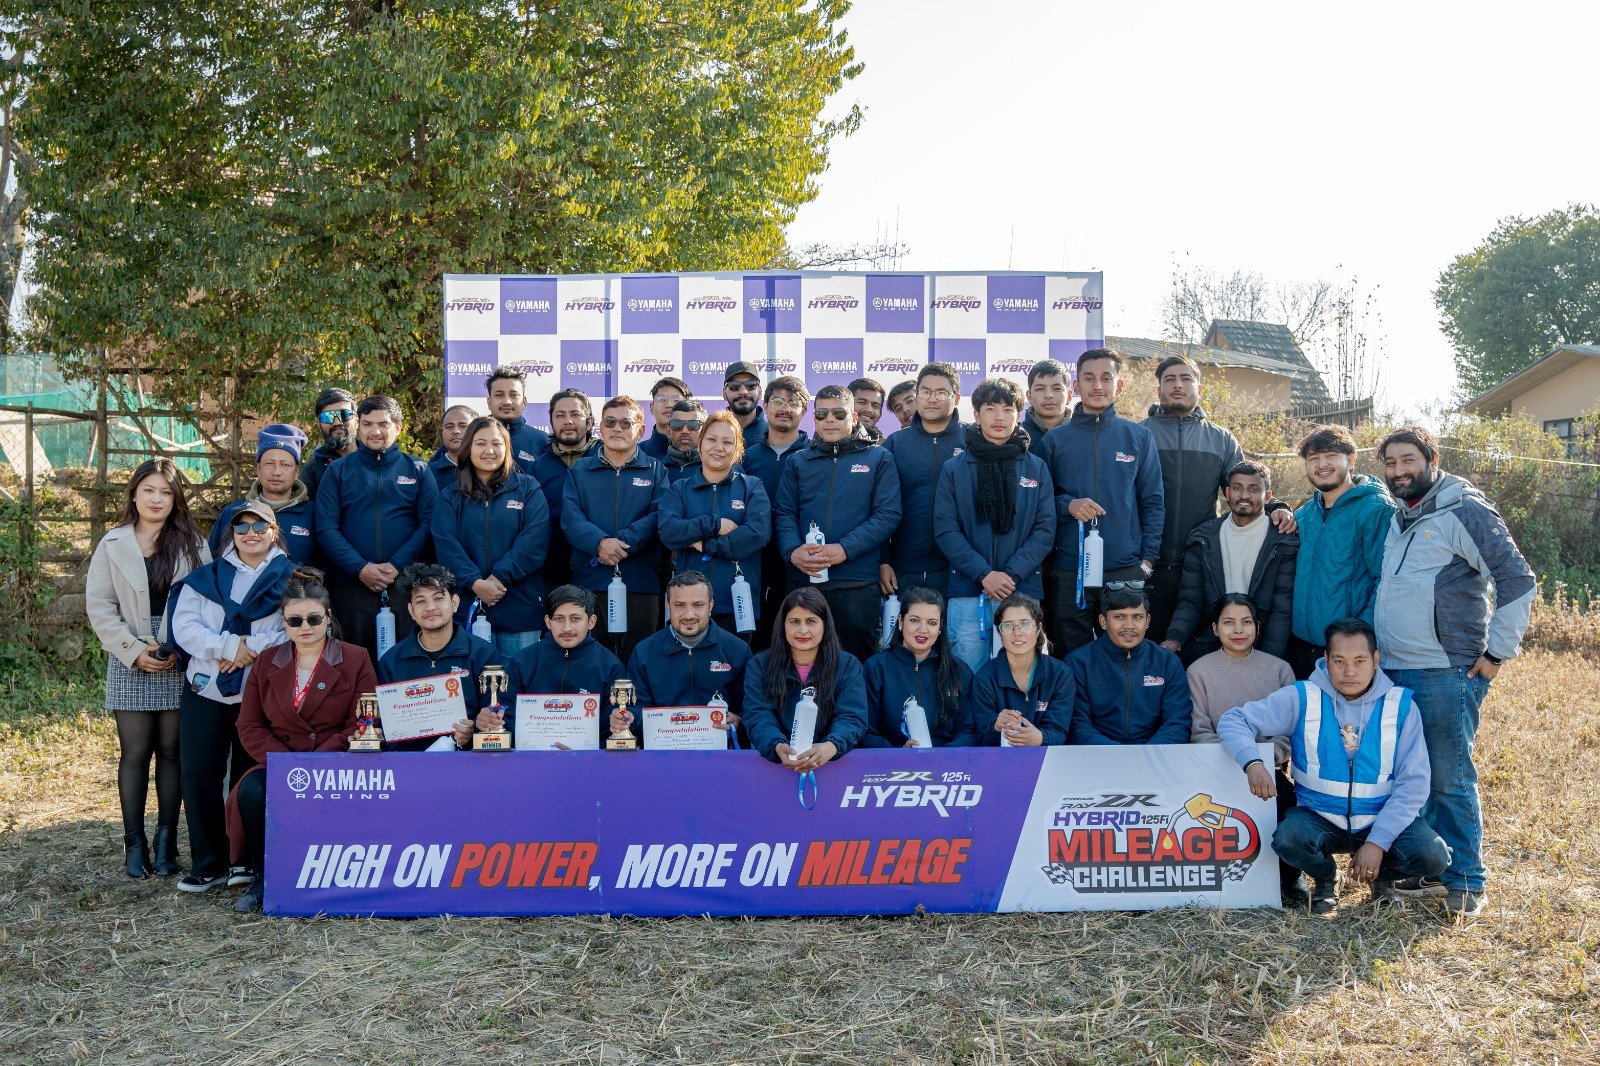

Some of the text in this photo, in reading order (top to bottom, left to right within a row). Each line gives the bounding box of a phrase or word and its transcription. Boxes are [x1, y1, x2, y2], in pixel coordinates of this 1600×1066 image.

[445, 302, 495, 315] HYBRID
[514, 300, 550, 310] YAMAHA
[565, 301, 616, 314] HYBRID
[638, 299, 673, 309] YAMAHA
[686, 301, 737, 313] HYBRID
[760, 298, 795, 308] YAMAHA
[807, 300, 859, 312] HYBRID
[882, 298, 918, 308] YAMAHA
[930, 300, 981, 312] HYBRID
[1003, 298, 1039, 308] YAMAHA
[1052, 301, 1103, 313] HYBRID
[457, 363, 492, 373] YAMAHA
[577, 362, 612, 372] YAMAHA
[624, 364, 675, 376] HYBRID
[700, 361, 733, 371] YAMAH
[754, 363, 797, 375] YBRID
[822, 361, 858, 371] YAMAHA
[868, 363, 919, 375] HYBRID
[990, 364, 1033, 376] HYBRI
[312, 769, 396, 791] YAMAHA
[840, 784, 983, 818] HYBRID
[1053, 810, 1169, 832] HYBRID 125Fi
[1047, 826, 1239, 865] MILEAGE
[295, 838, 973, 891] HIGH ON POWER, MORE ON MILEAGE
[1073, 865, 1216, 888] CHALLENGE
